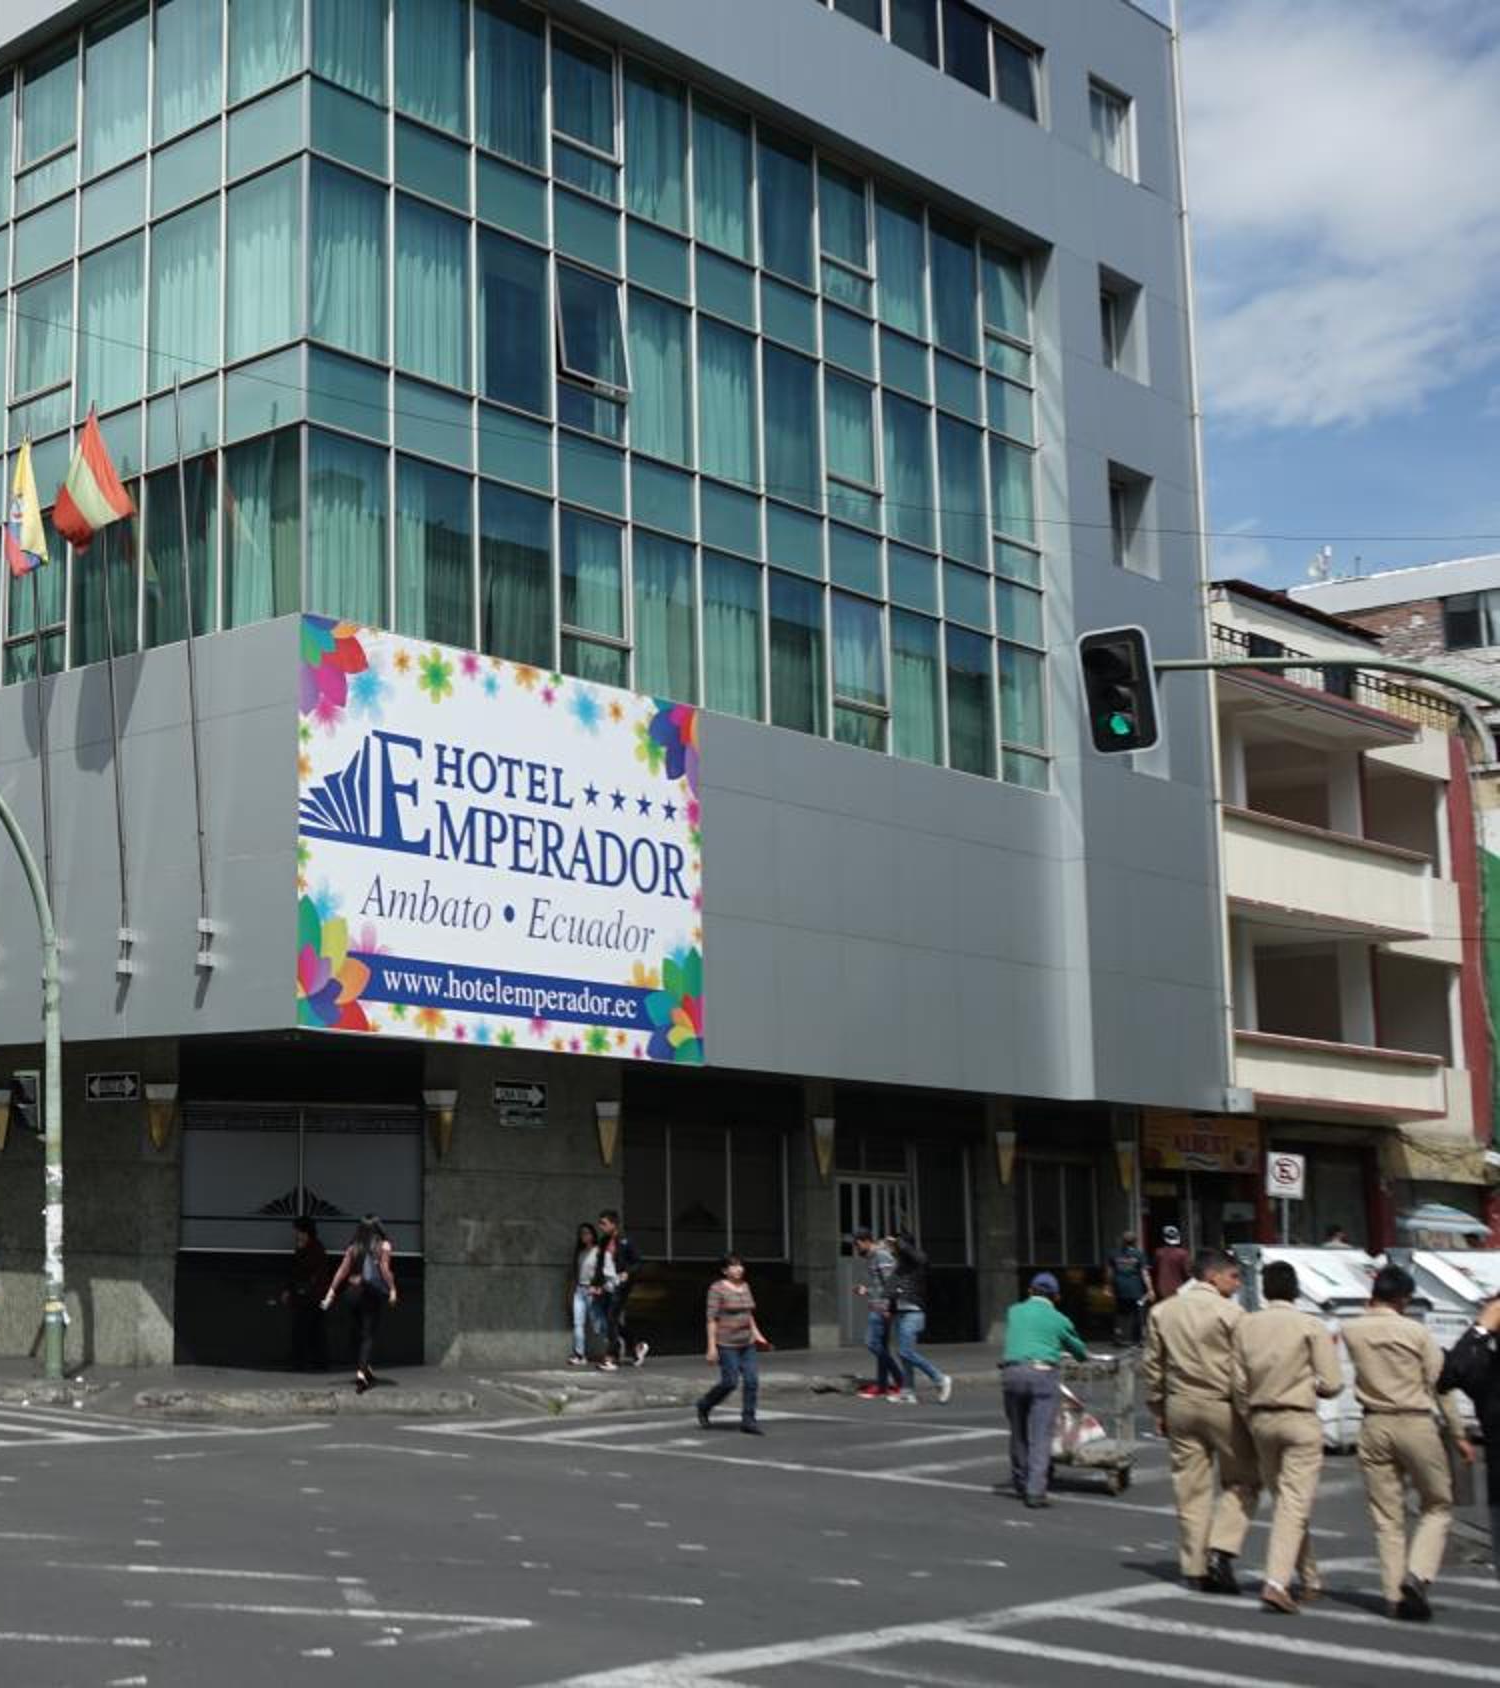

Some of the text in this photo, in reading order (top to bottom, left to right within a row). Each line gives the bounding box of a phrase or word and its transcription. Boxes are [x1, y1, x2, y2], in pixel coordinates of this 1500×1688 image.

[434, 743, 575, 809] HOTEL
[371, 729, 689, 899] EMPERADOR
[360, 873, 656, 953] Ambato Ecuador
[382, 968, 638, 1020] www.hotelemperador.ec
